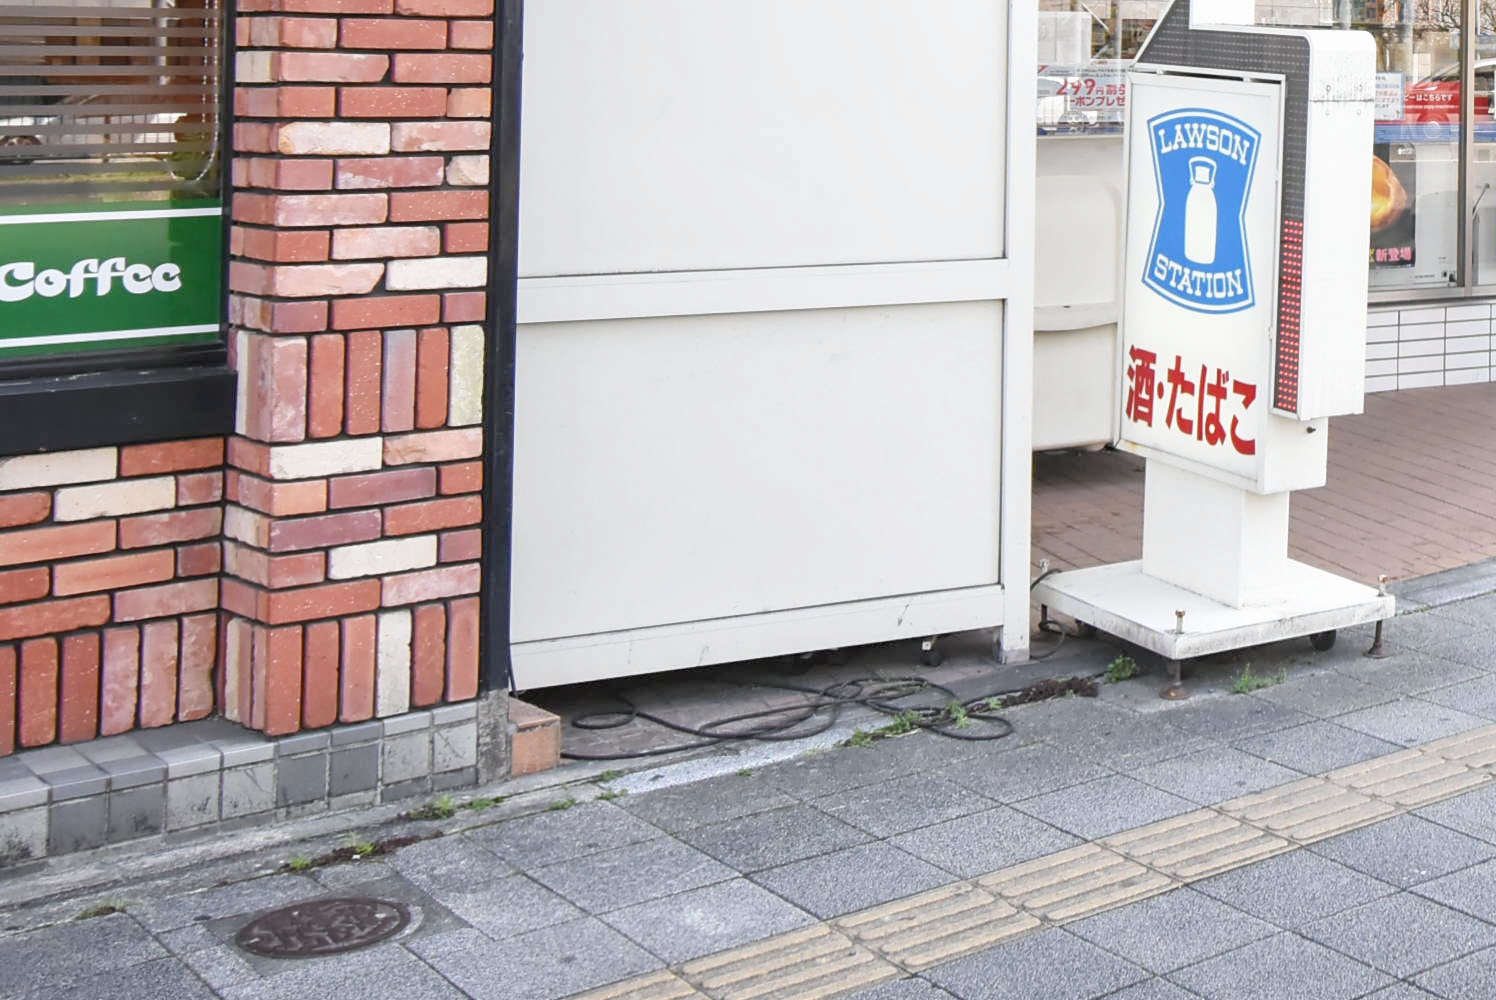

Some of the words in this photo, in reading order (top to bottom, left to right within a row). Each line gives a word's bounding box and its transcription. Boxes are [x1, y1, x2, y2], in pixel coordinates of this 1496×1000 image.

[1157, 122, 1251, 166] LAWSON
[0, 257, 182, 302] Coffee
[1153, 253, 1245, 299] STATION
[1125, 343, 1258, 457] 酒・たばこ
